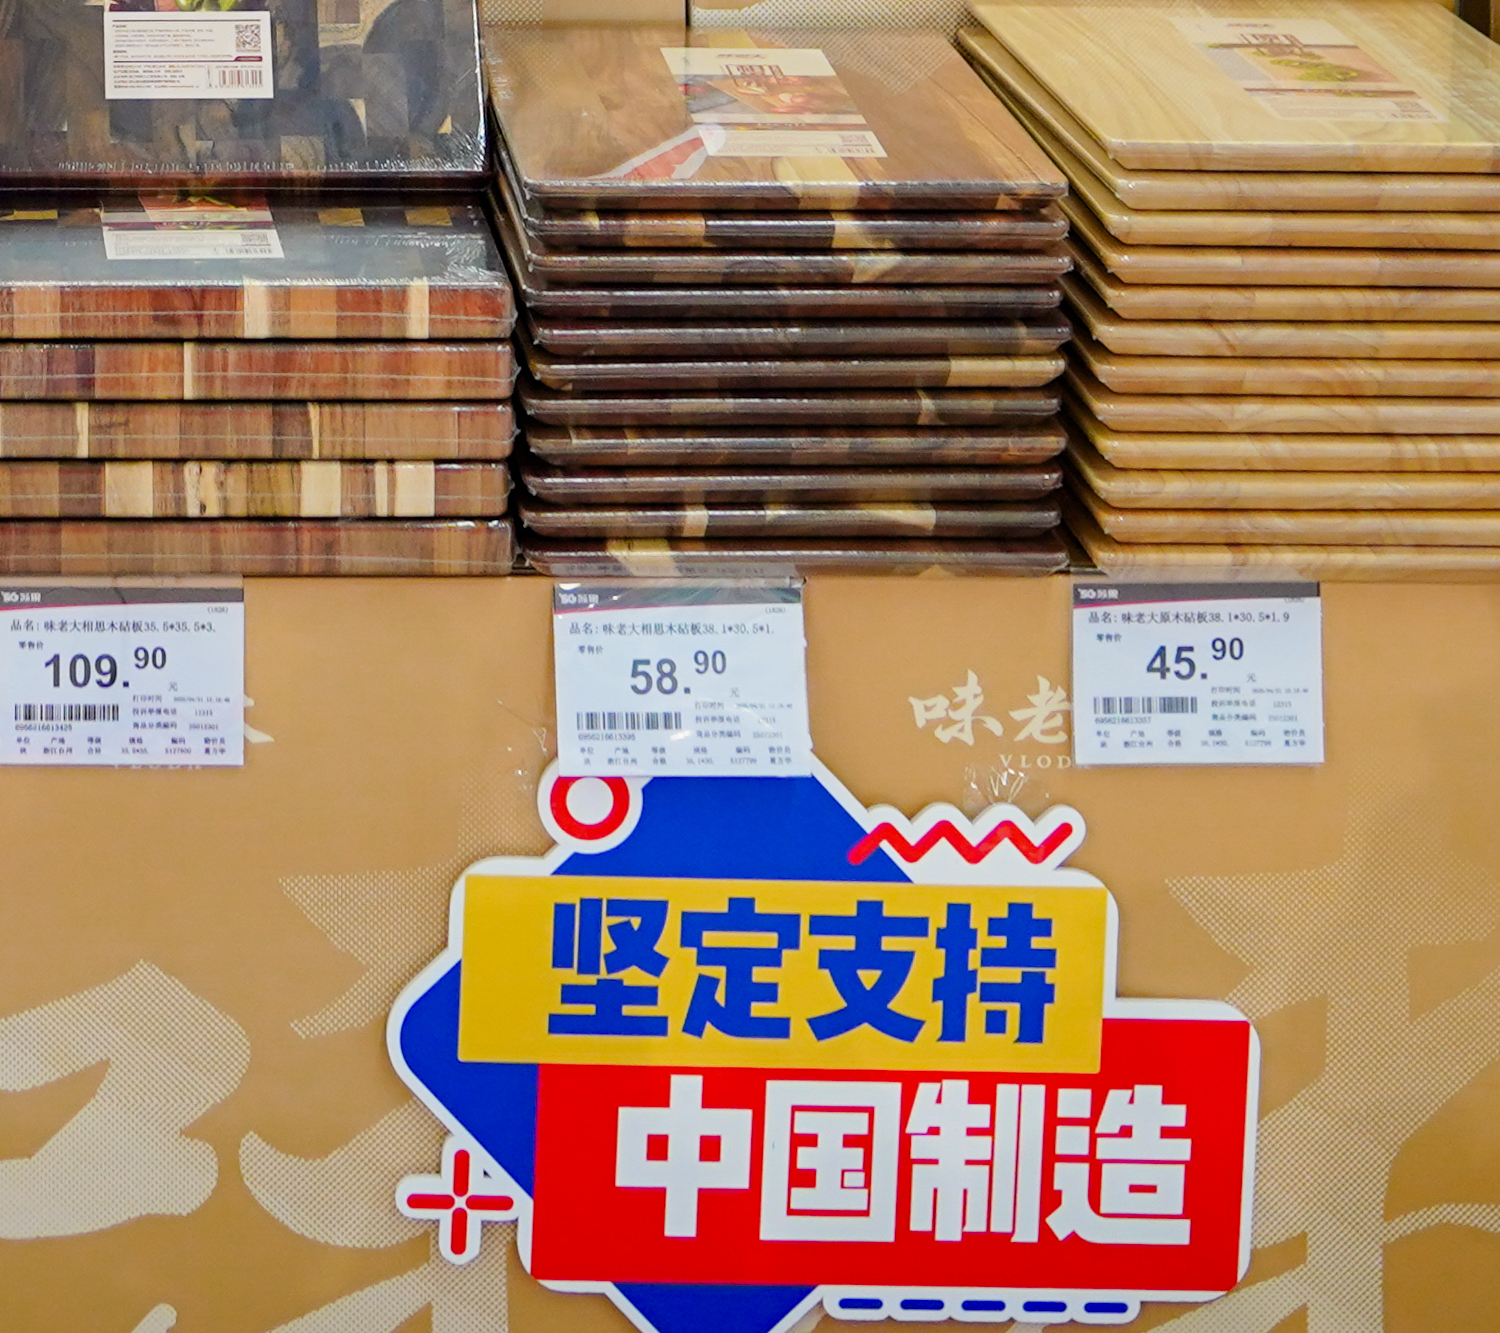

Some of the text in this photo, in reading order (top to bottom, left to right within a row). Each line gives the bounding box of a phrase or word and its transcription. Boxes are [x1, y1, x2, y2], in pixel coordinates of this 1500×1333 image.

[549, 896, 1057, 1045] 坚定支持
[615, 1075, 1192, 1244] 中国制造
